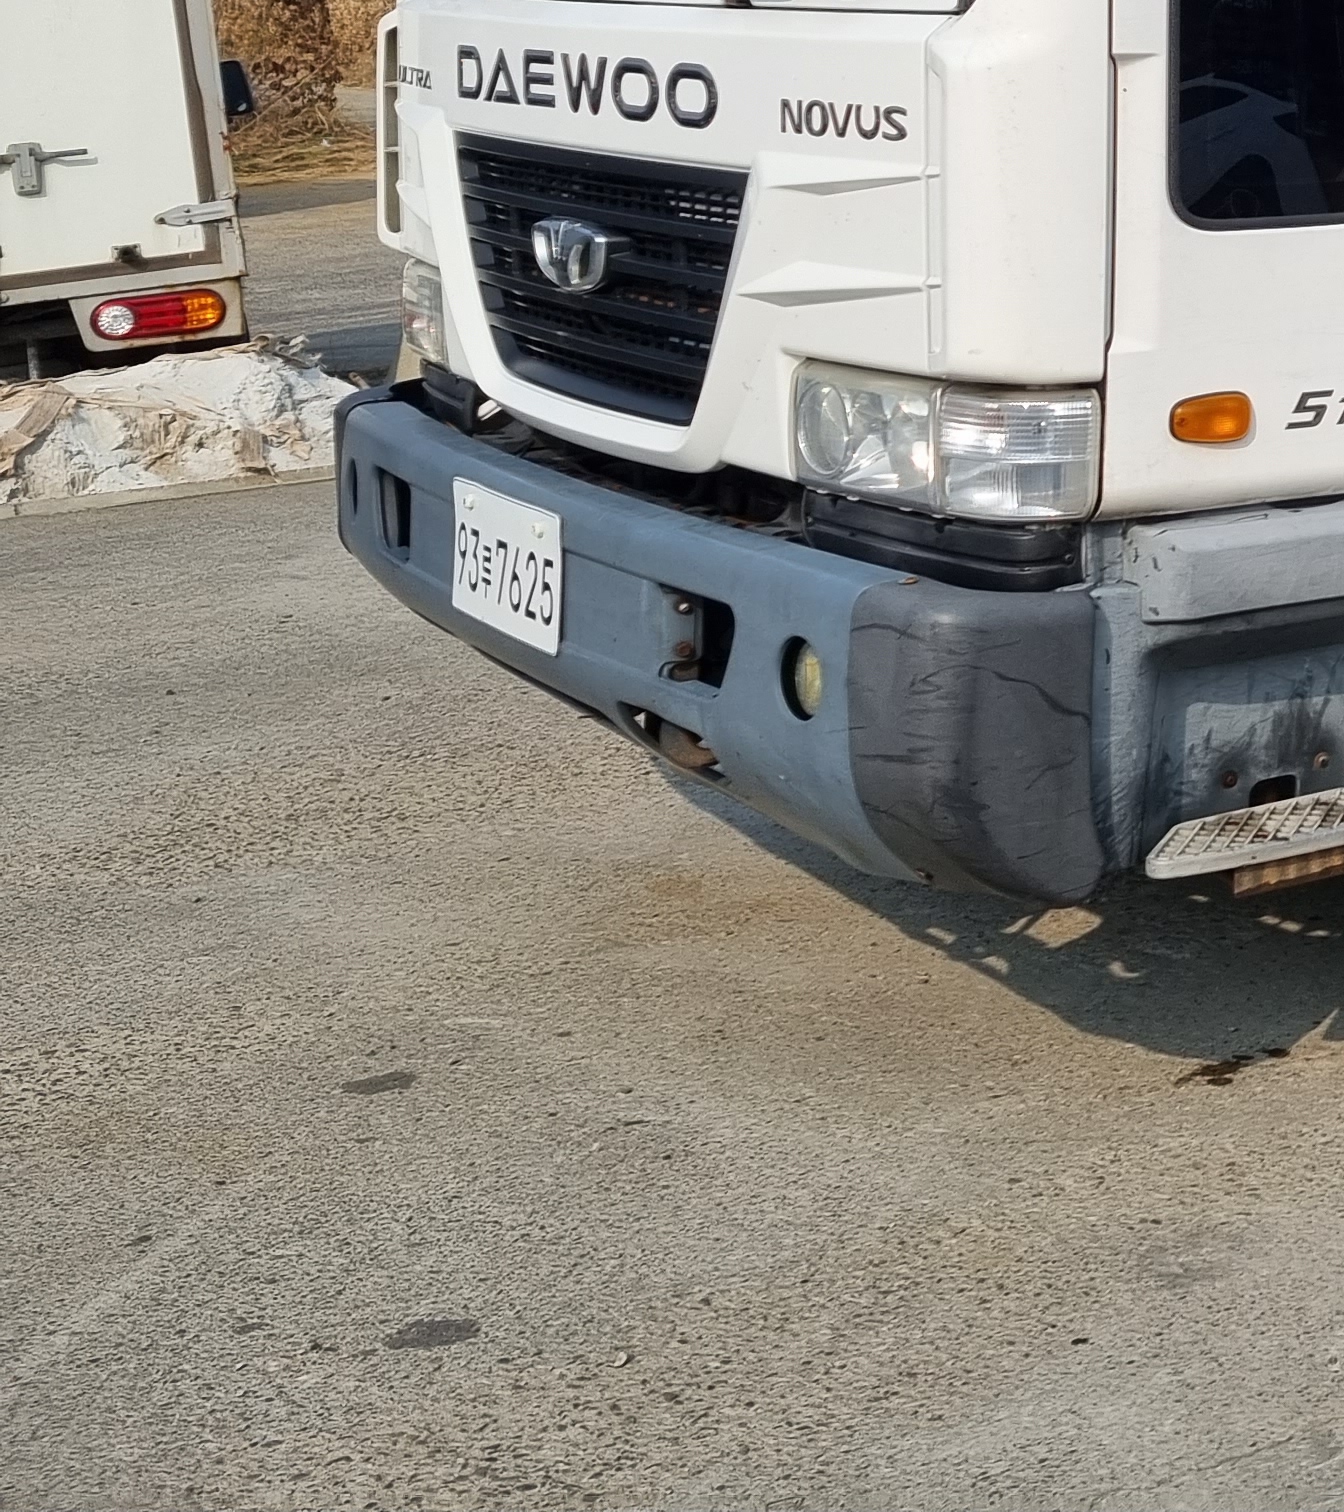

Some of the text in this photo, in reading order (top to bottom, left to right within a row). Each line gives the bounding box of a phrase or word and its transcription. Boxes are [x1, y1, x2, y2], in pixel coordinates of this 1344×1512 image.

[398, 64, 433, 90] ULTRA
[457, 44, 719, 130] DAEWOO
[780, 98, 909, 142] NOVUS
